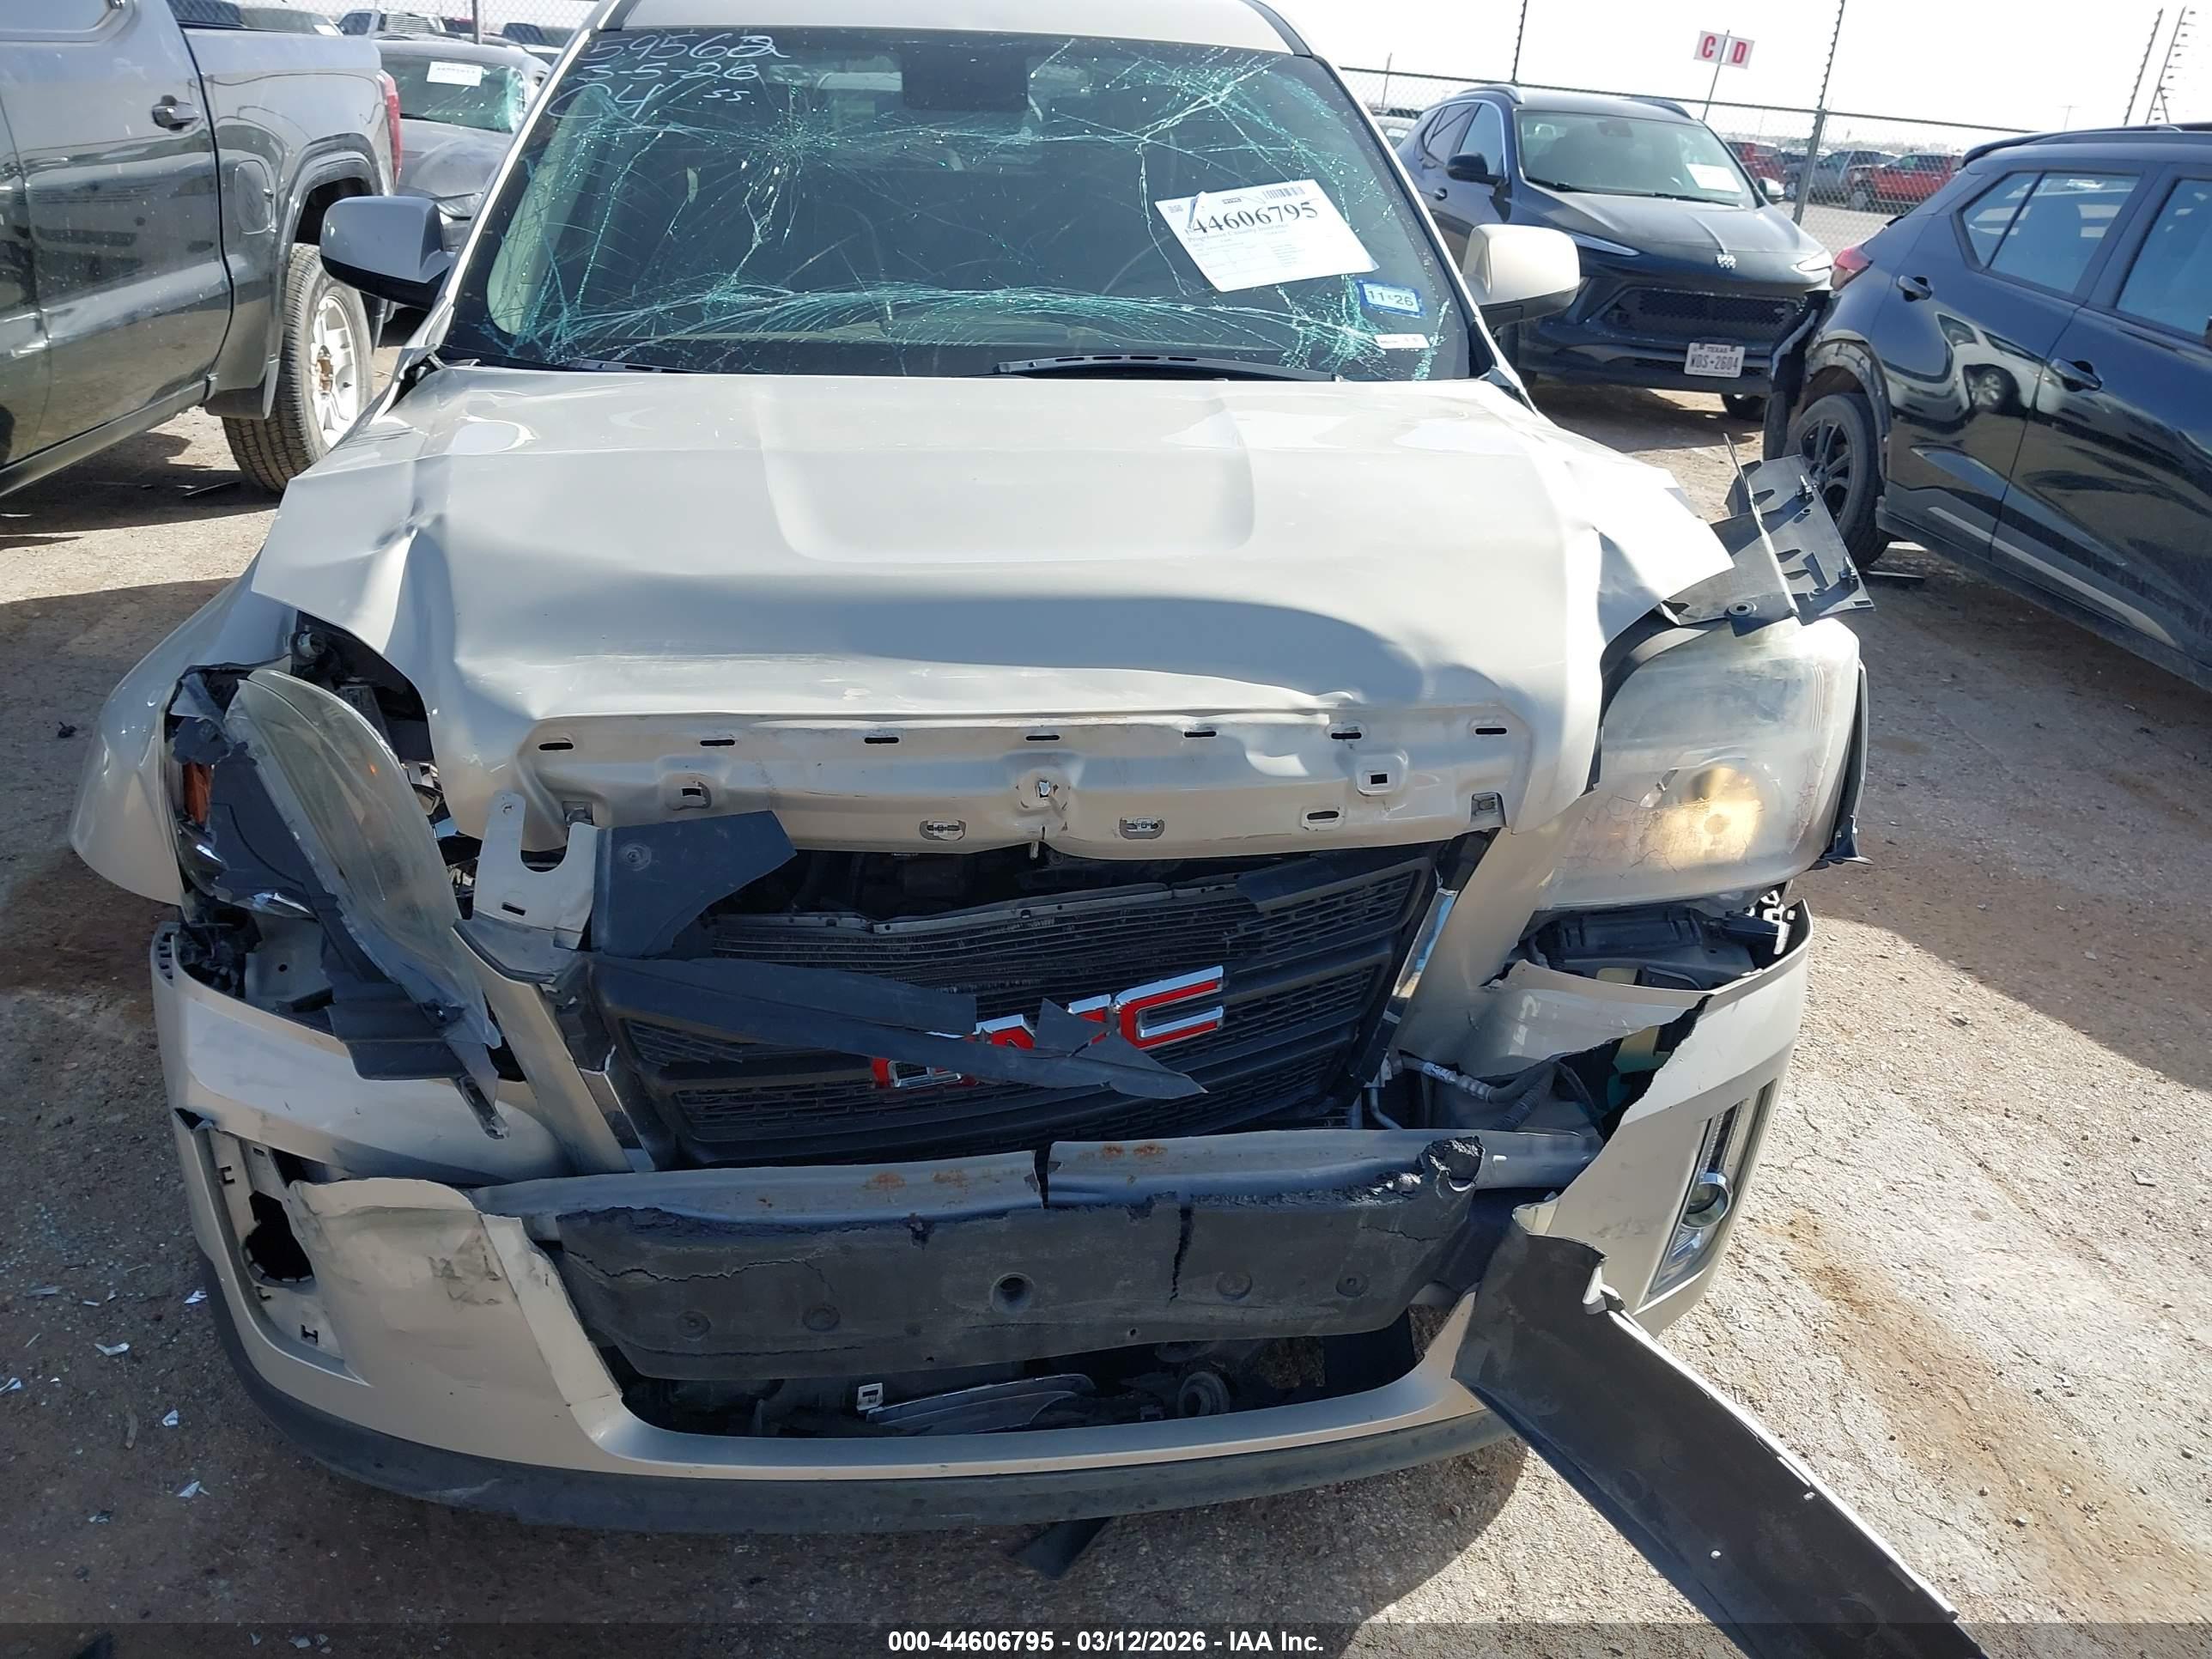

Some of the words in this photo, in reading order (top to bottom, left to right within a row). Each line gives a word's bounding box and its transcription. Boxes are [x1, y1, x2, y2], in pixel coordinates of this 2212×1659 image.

[1702, 35, 1717, 58] C
[1732, 41, 1747, 64] D
[1191, 198, 1320, 234] 44606795
[1368, 290, 1384, 301] 11
[1394, 295, 1414, 307] 26
